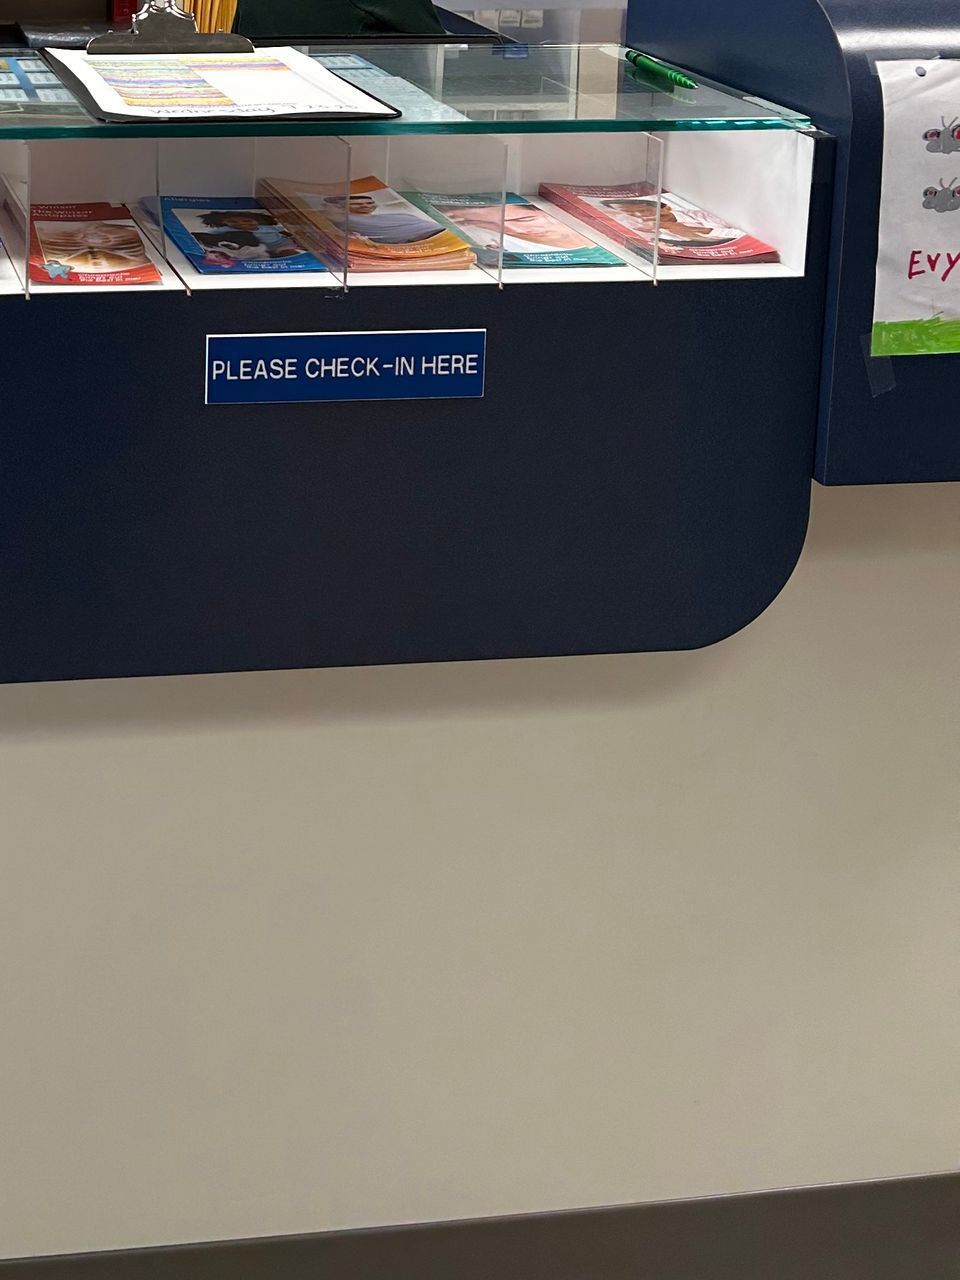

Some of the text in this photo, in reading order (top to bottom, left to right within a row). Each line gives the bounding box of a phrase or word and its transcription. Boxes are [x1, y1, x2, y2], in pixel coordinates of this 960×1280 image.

[212, 354, 479, 380] PLEASE CHECK-IN HERE
